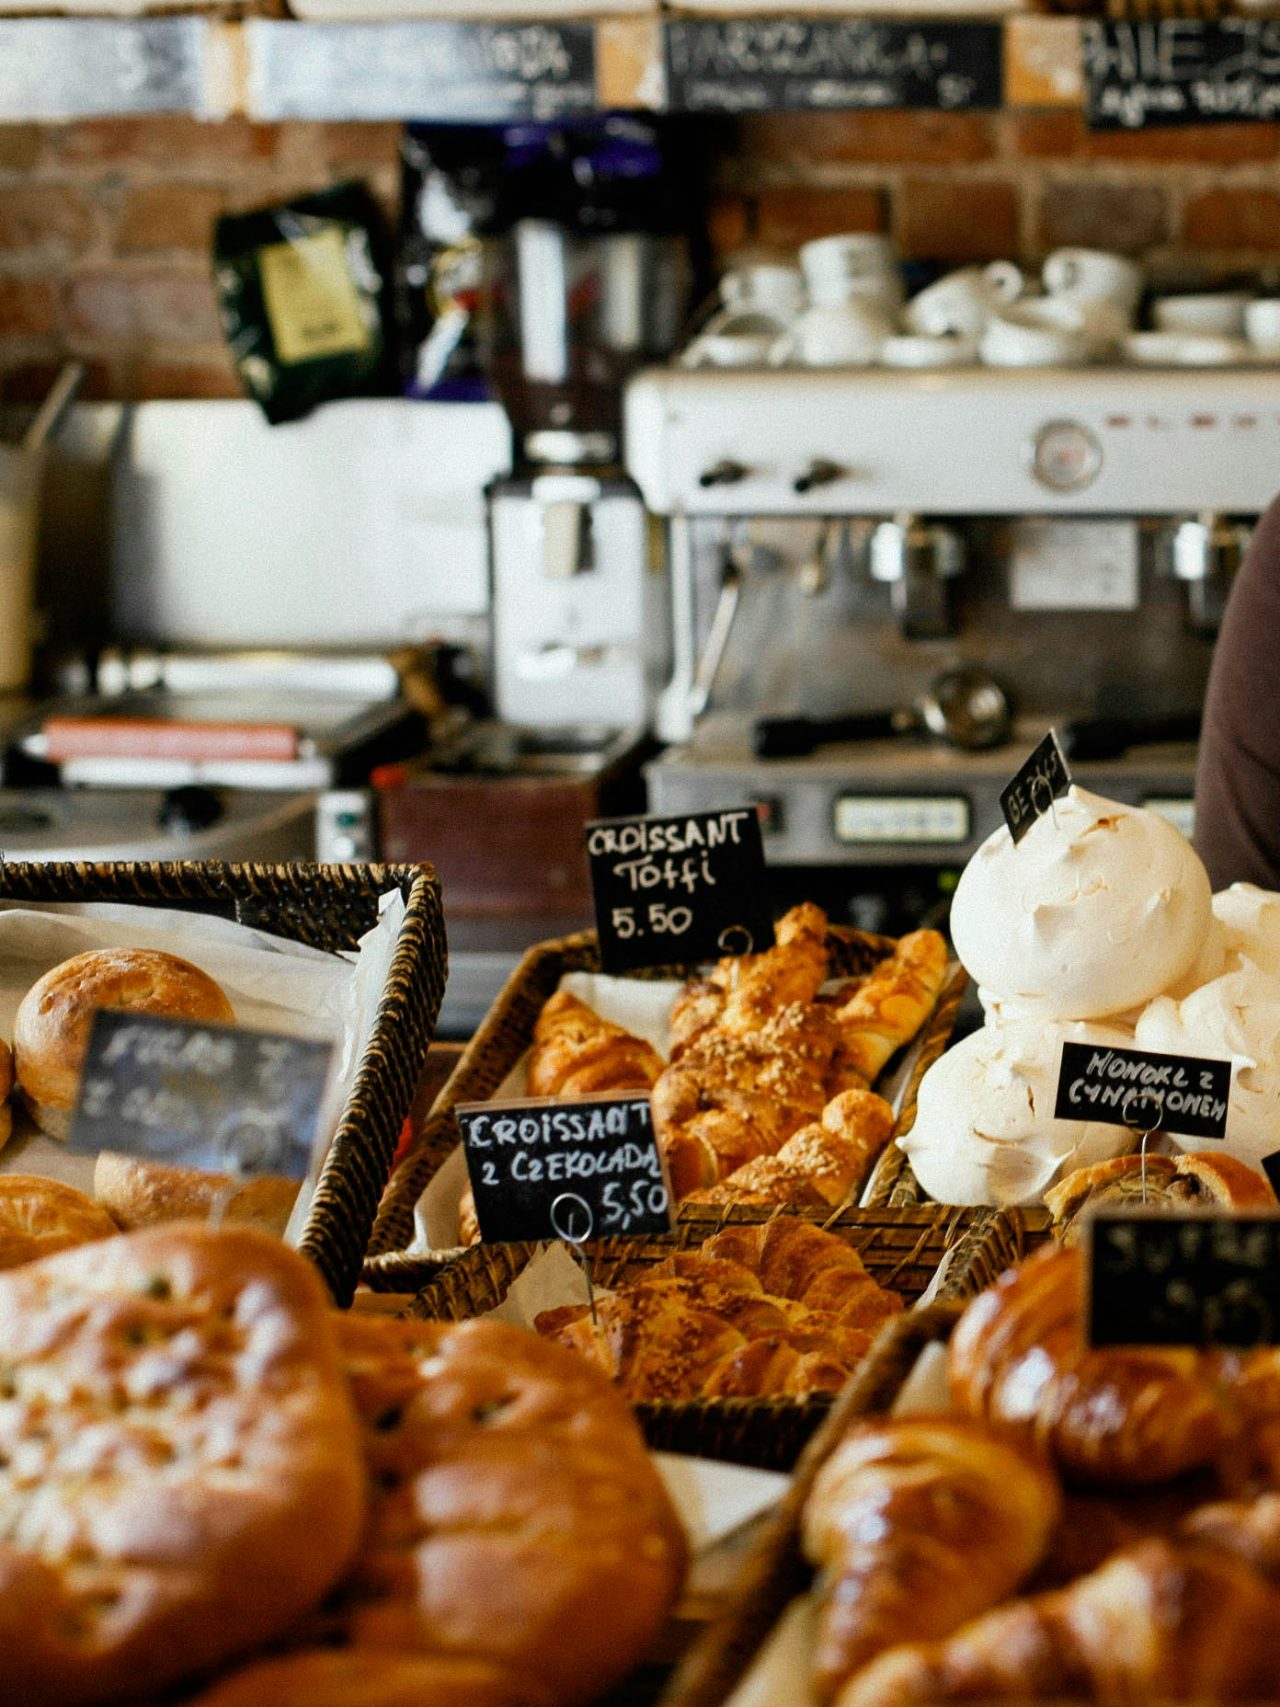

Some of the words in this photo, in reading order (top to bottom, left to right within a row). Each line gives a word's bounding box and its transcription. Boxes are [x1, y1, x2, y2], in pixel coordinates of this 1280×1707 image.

[588, 812, 749, 855] CROISSANT
[613, 850, 716, 893] Toffi
[612, 903, 692, 939] 5.50
[468, 1103, 651, 1148] CROISSANT
[602, 1179, 669, 1230] 5,50
